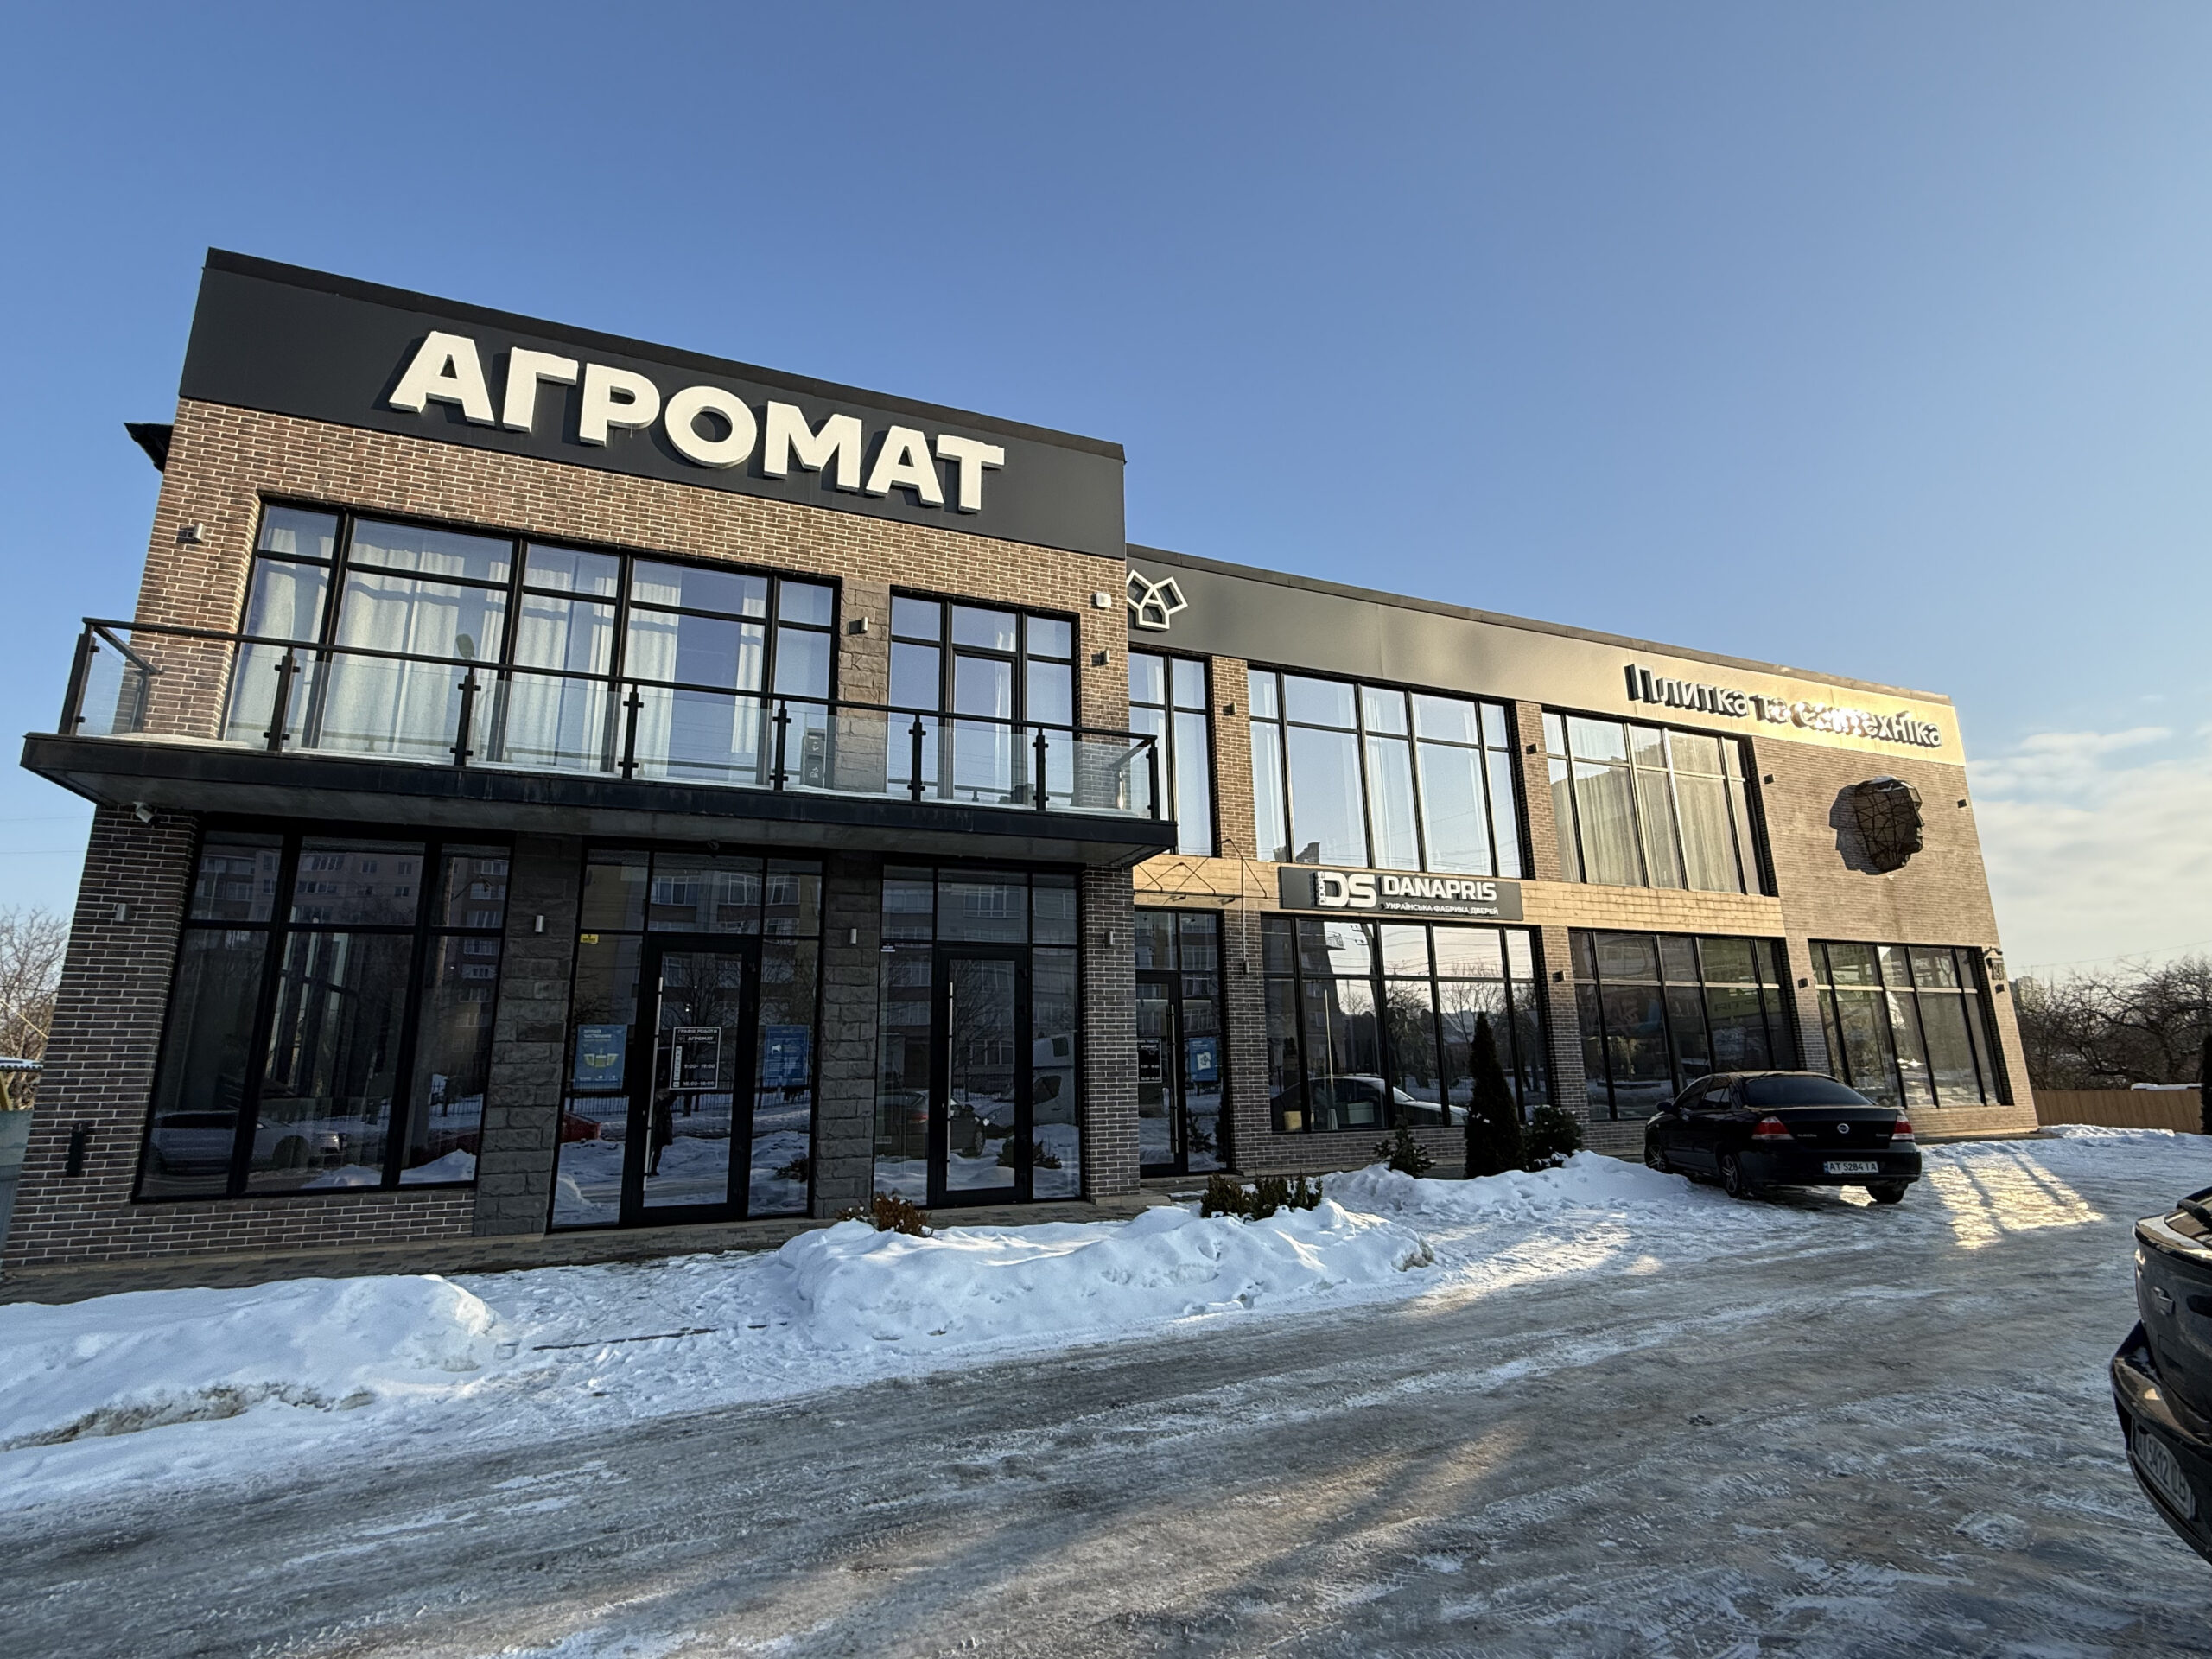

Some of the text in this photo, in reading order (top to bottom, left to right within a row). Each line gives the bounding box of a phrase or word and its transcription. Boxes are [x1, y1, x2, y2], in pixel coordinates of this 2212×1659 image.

[388, 330, 1005, 514] АГРОМАТ
[1624, 664, 1750, 718] Плитка
[1317, 871, 1326, 906] DOORS
[1323, 871, 1377, 908] DS
[1382, 875, 1497, 901] DANAPRIS
[1384, 901, 1433, 912] УКРАЇНСЬКА
[1470, 906, 1499, 916] ДВЕРЕЙ
[1829, 1161, 1840, 1171] AT
